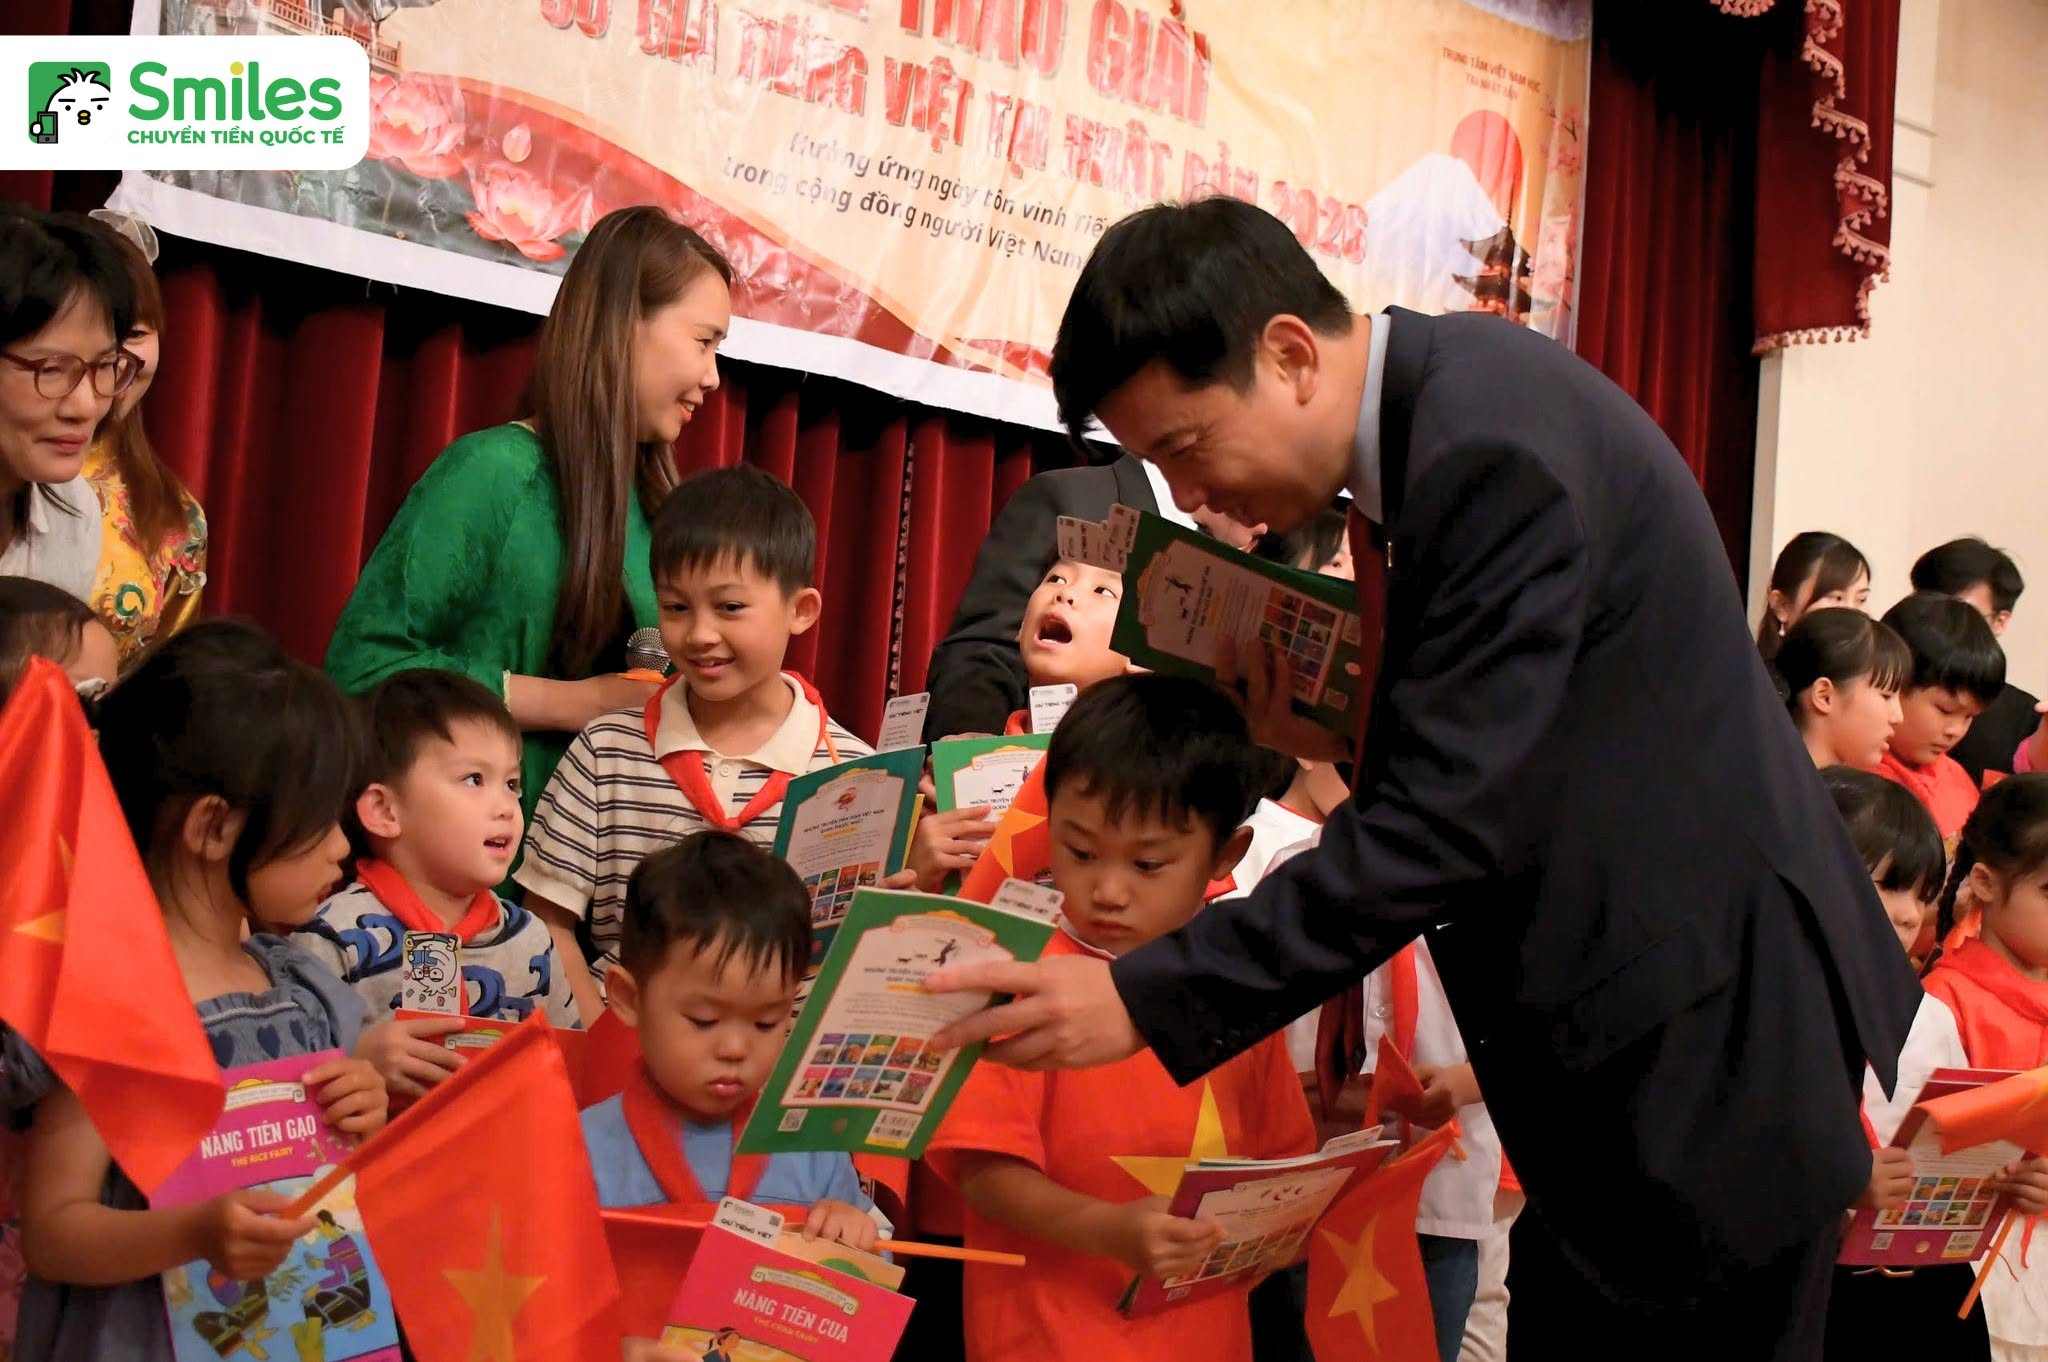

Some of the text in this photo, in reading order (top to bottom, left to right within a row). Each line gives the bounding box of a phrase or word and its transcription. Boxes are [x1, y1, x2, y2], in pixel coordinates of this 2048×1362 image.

[884, 56, 975, 153] VIỆT
[878, 153, 924, 190] ứng
[723, 154, 789, 197] trong
[797, 177, 853, 214] cộng
[859, 189, 918, 229] đồng
[920, 207, 984, 244] người
[987, 225, 1027, 259] Việt
[201, 1114, 318, 1160] NÀNG TIÊN GẠO
[733, 1287, 850, 1344] NÀNG TIÊN CUA
